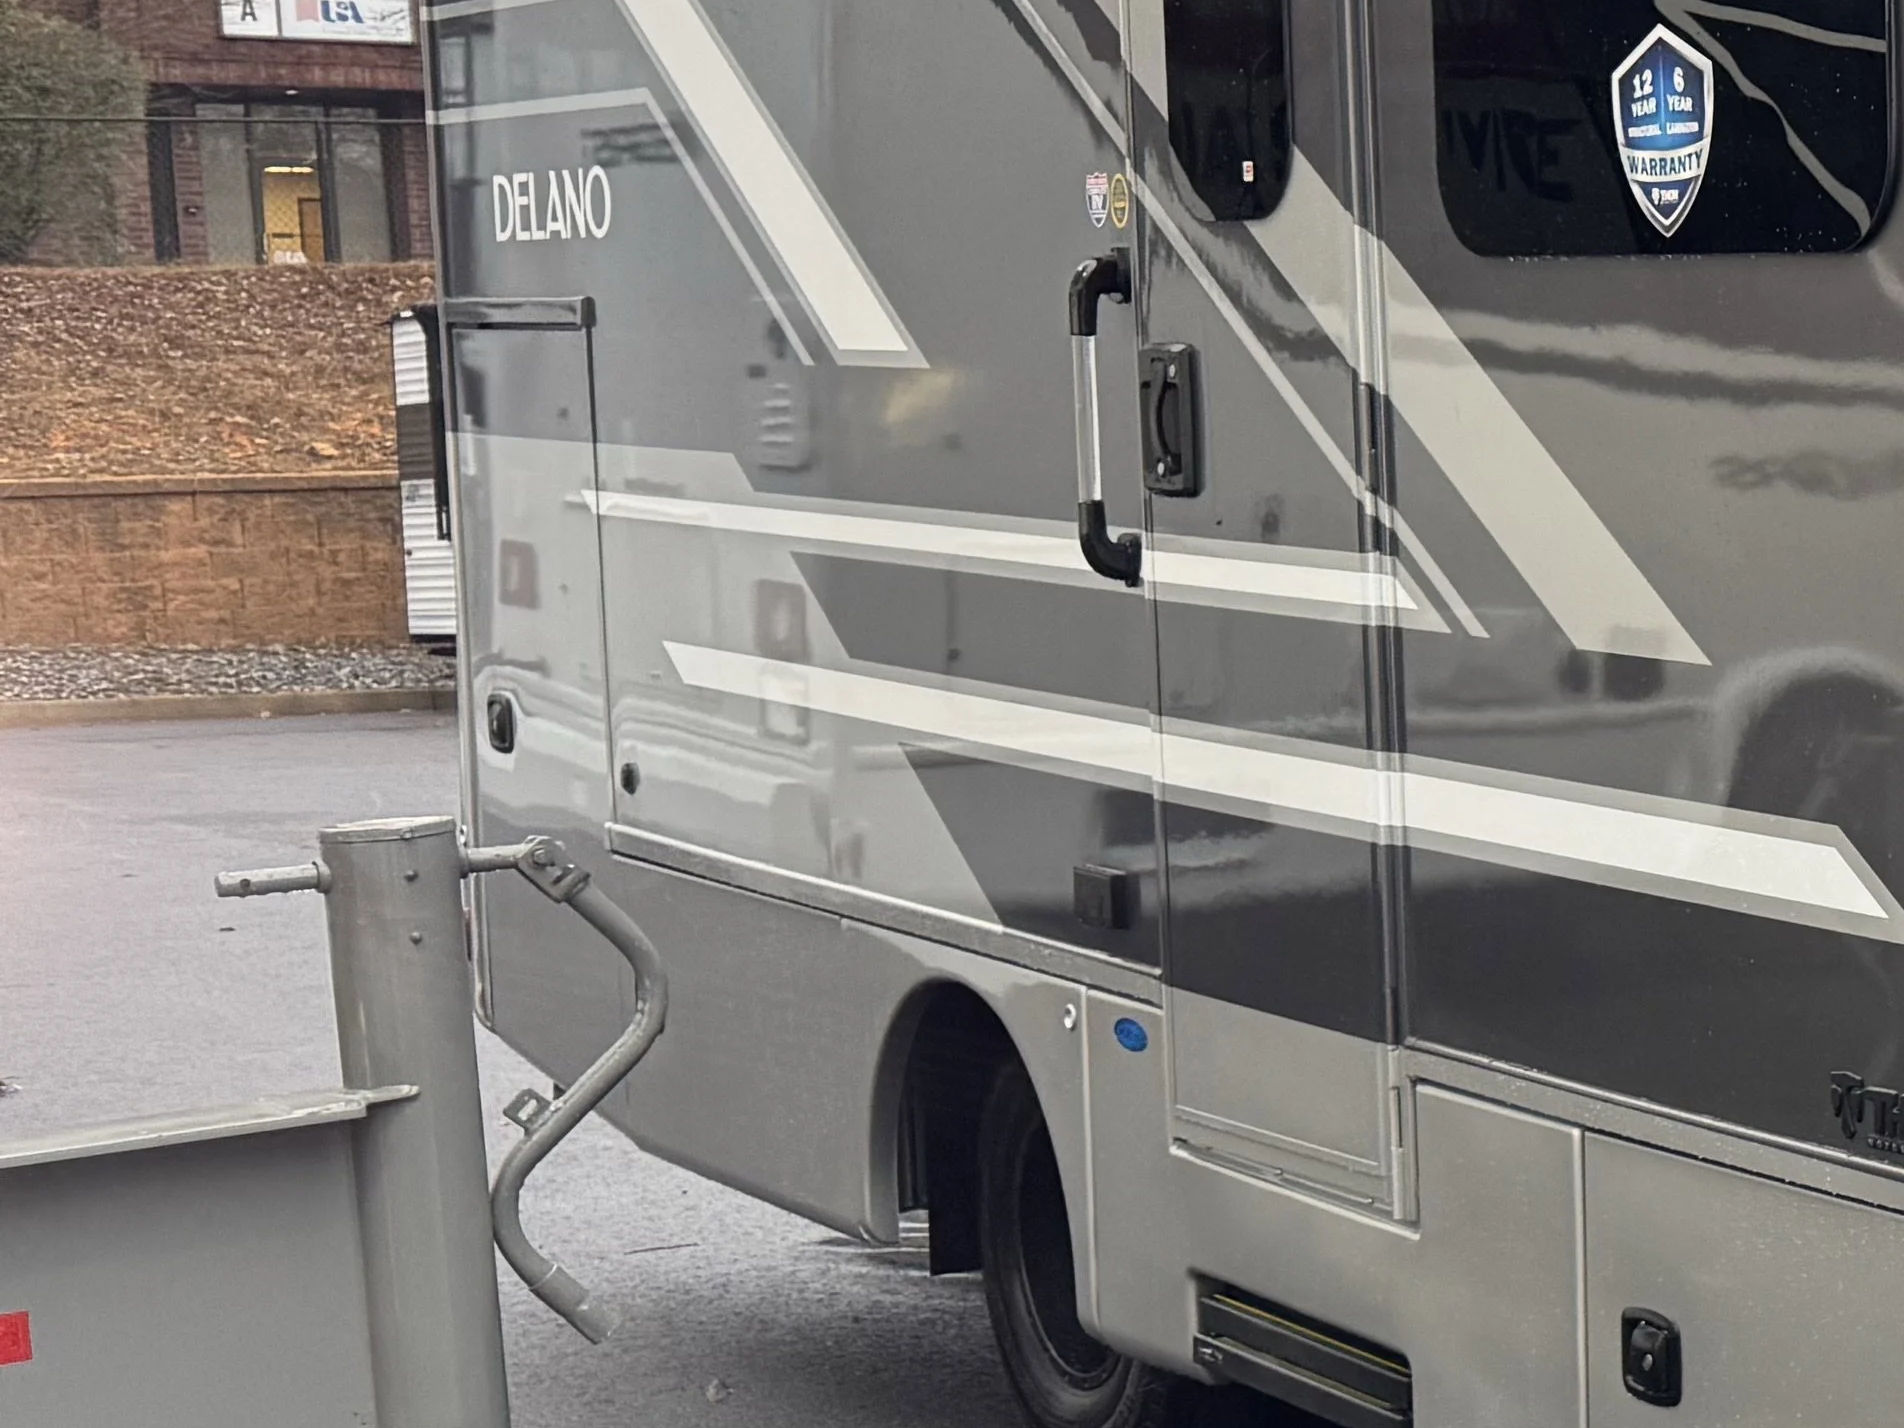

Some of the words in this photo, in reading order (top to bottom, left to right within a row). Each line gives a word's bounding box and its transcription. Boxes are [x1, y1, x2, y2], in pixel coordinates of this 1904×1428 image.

[1632, 68, 1653, 99] 12
[1673, 66, 1685, 93] 6
[1631, 97, 1656, 118] YEAR
[1666, 94, 1693, 113] YEAR
[1627, 147, 1704, 177] WARRANTY
[492, 164, 612, 242] DELANO
